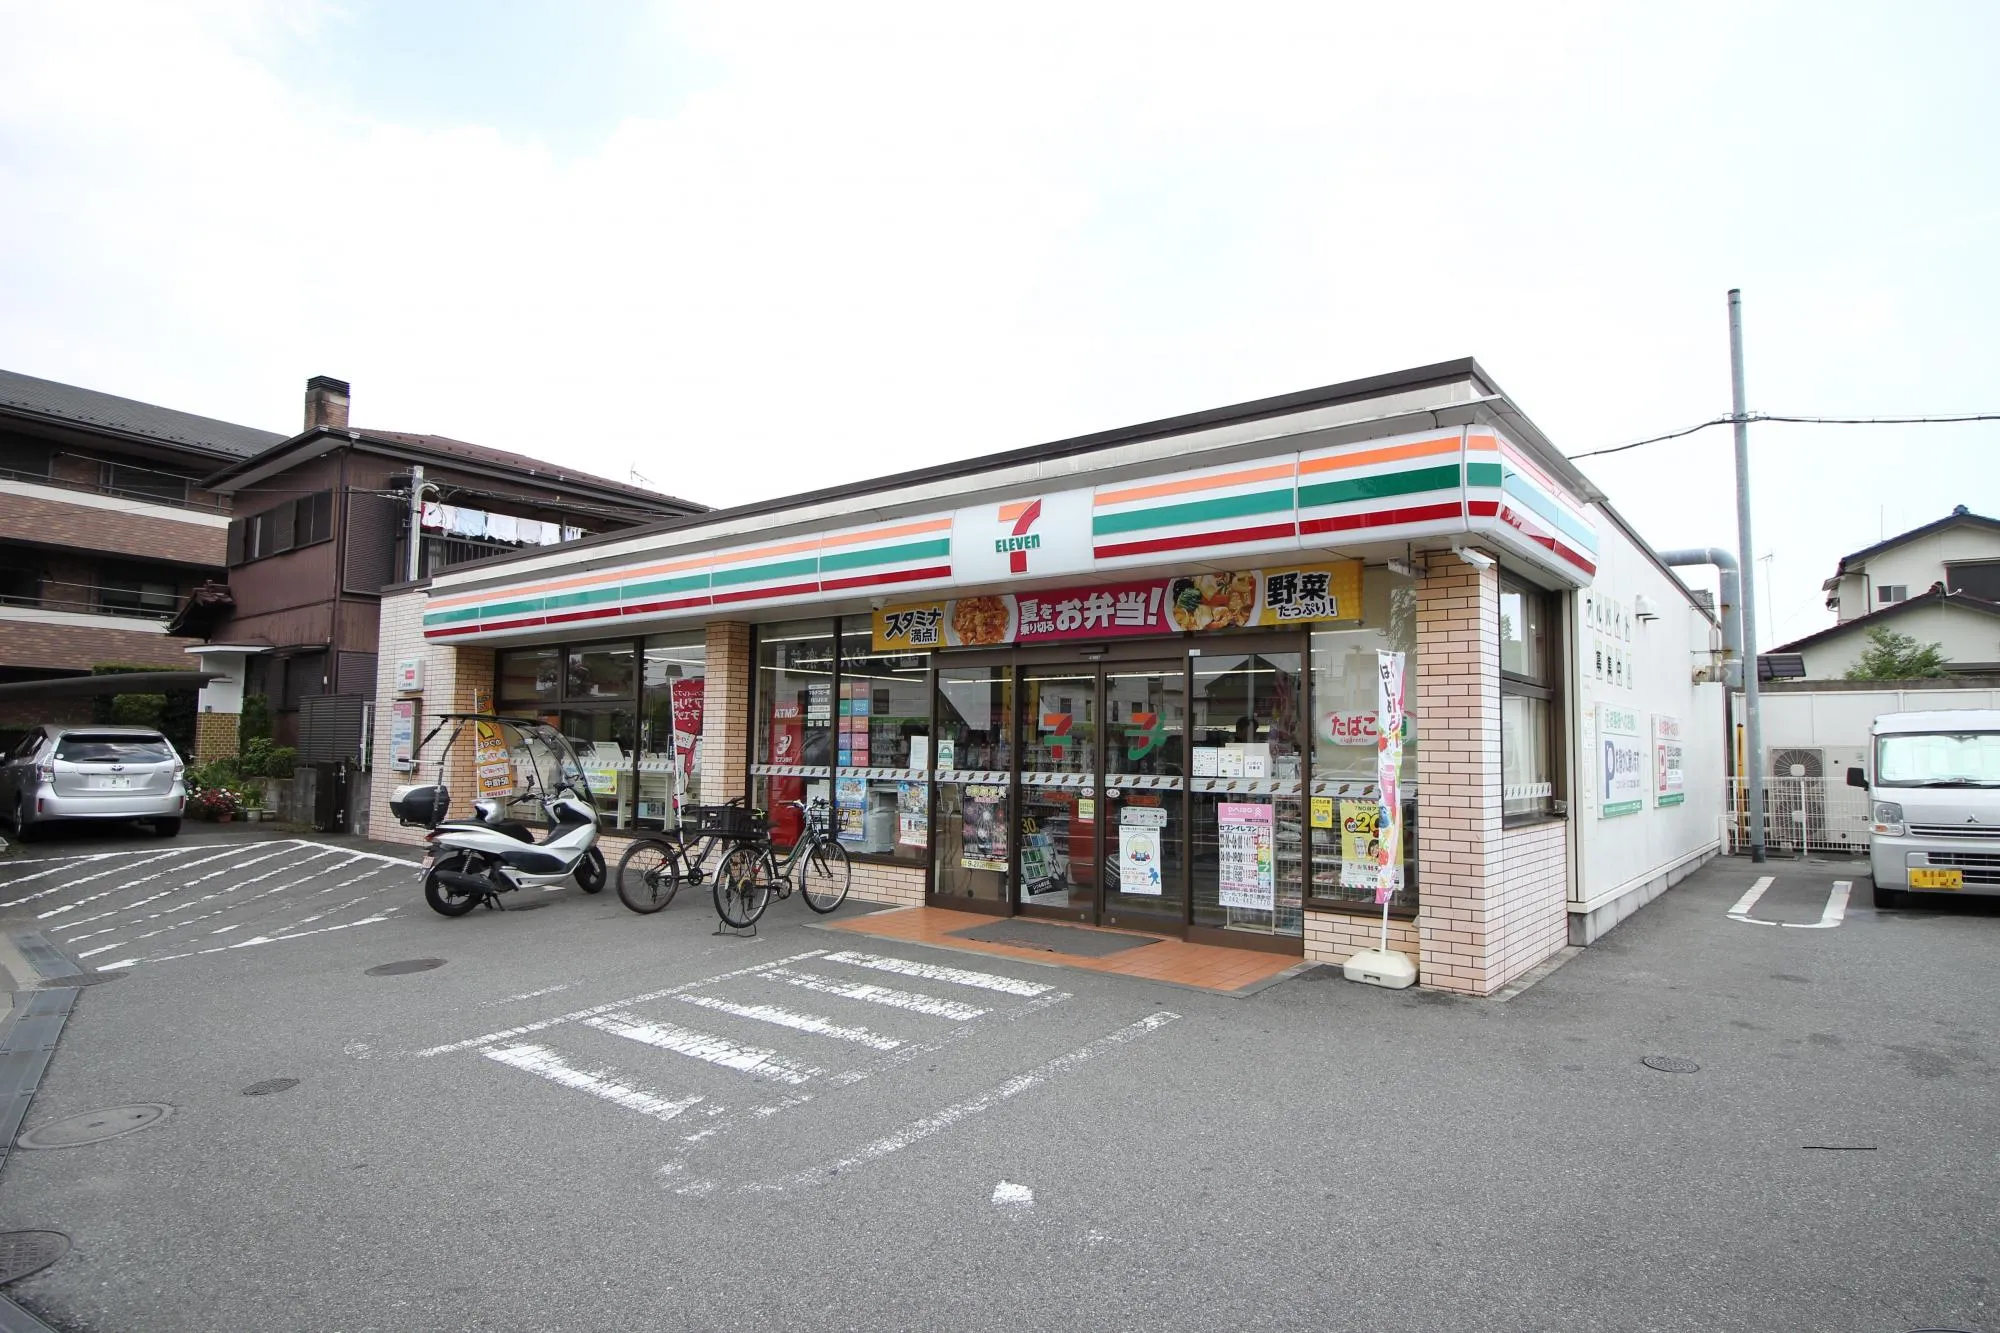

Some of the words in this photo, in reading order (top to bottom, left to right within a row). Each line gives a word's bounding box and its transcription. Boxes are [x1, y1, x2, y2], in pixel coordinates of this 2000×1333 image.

[1267, 572, 1332, 606] 野菜
[1020, 599, 1053, 623] 夏を
[1056, 587, 1165, 632] お弁当!
[1278, 599, 1336, 619] たっぷり!
[885, 607, 943, 639] スタミナ
[1020, 621, 1054, 636] 乗り切る
[910, 628, 938, 644] 満点!
[1332, 715, 1377, 737] たばこ
[1604, 740, 1616, 799] P
